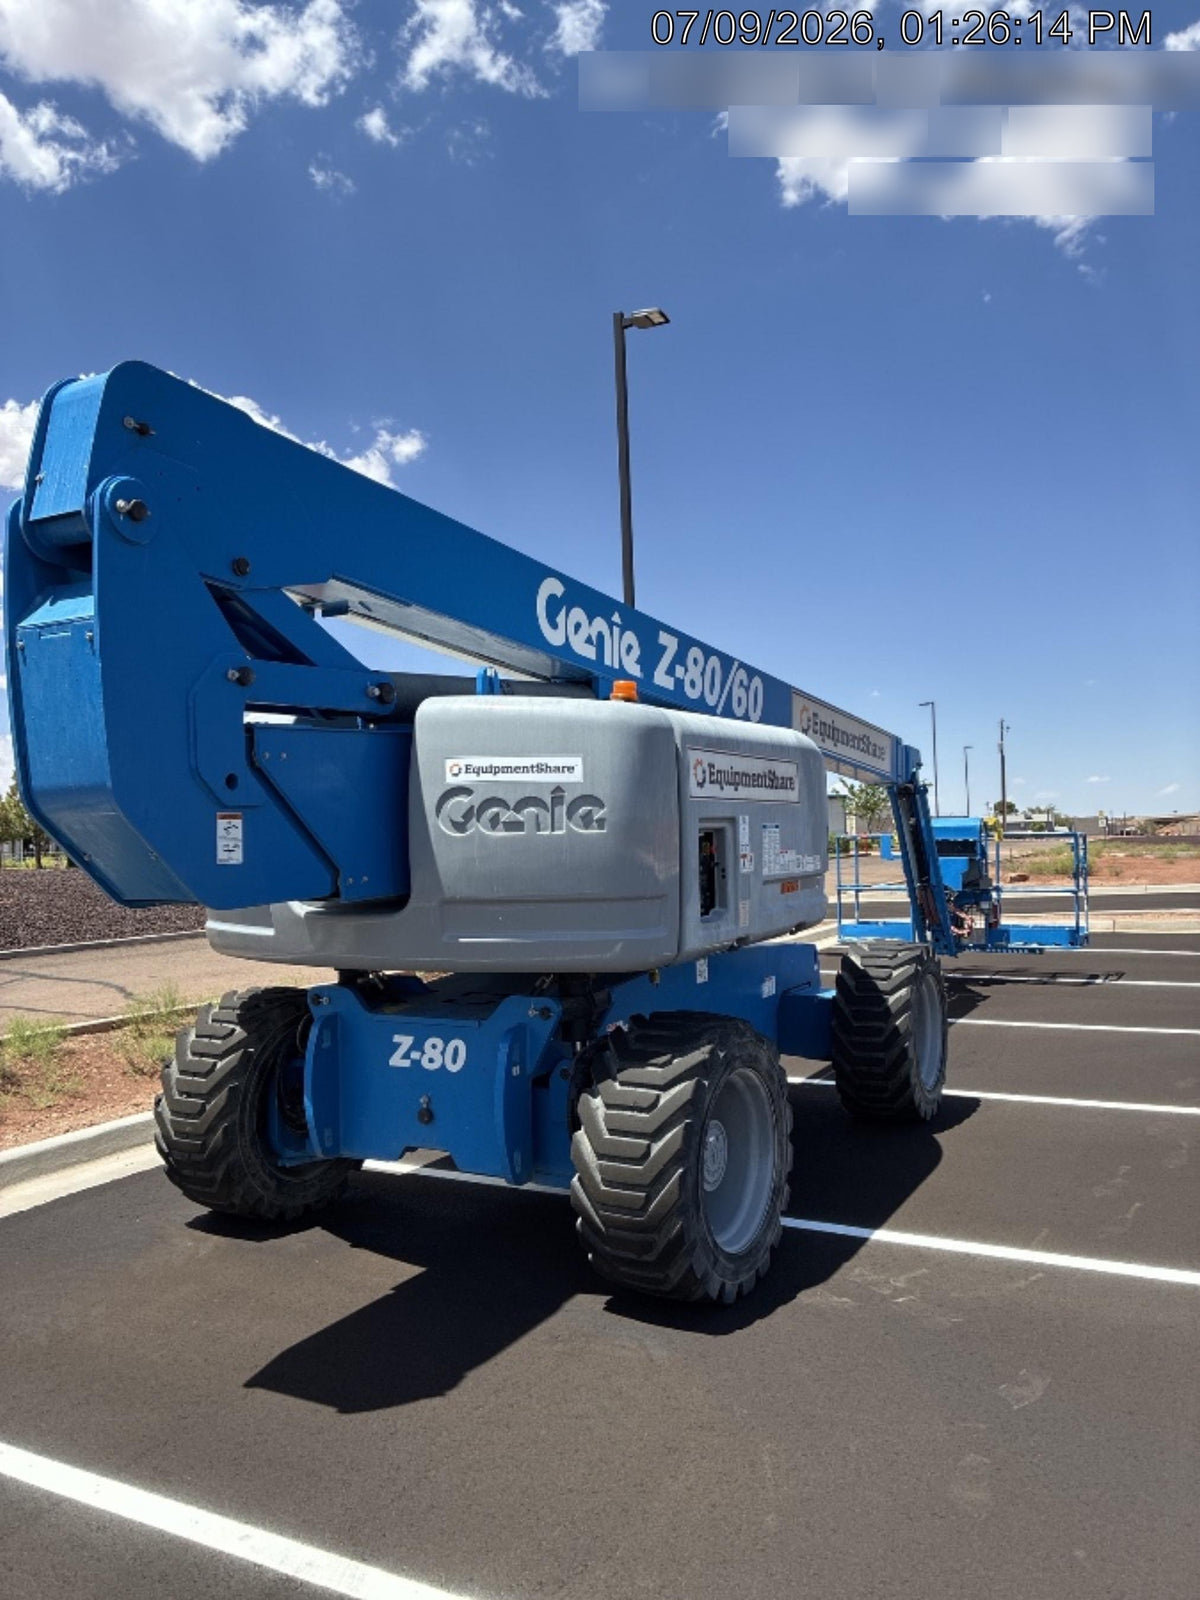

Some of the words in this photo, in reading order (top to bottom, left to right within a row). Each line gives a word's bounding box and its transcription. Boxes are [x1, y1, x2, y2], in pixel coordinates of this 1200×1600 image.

[536, 577, 644, 679] Genie
[653, 630, 764, 723] Z-80/60
[811, 711, 886, 762] EquipmentShare
[464, 762, 576, 777] EquipmentShare
[707, 762, 795, 792] EquipmentShare
[435, 785, 607, 837] Genie
[388, 1034, 467, 1073] Z-80
